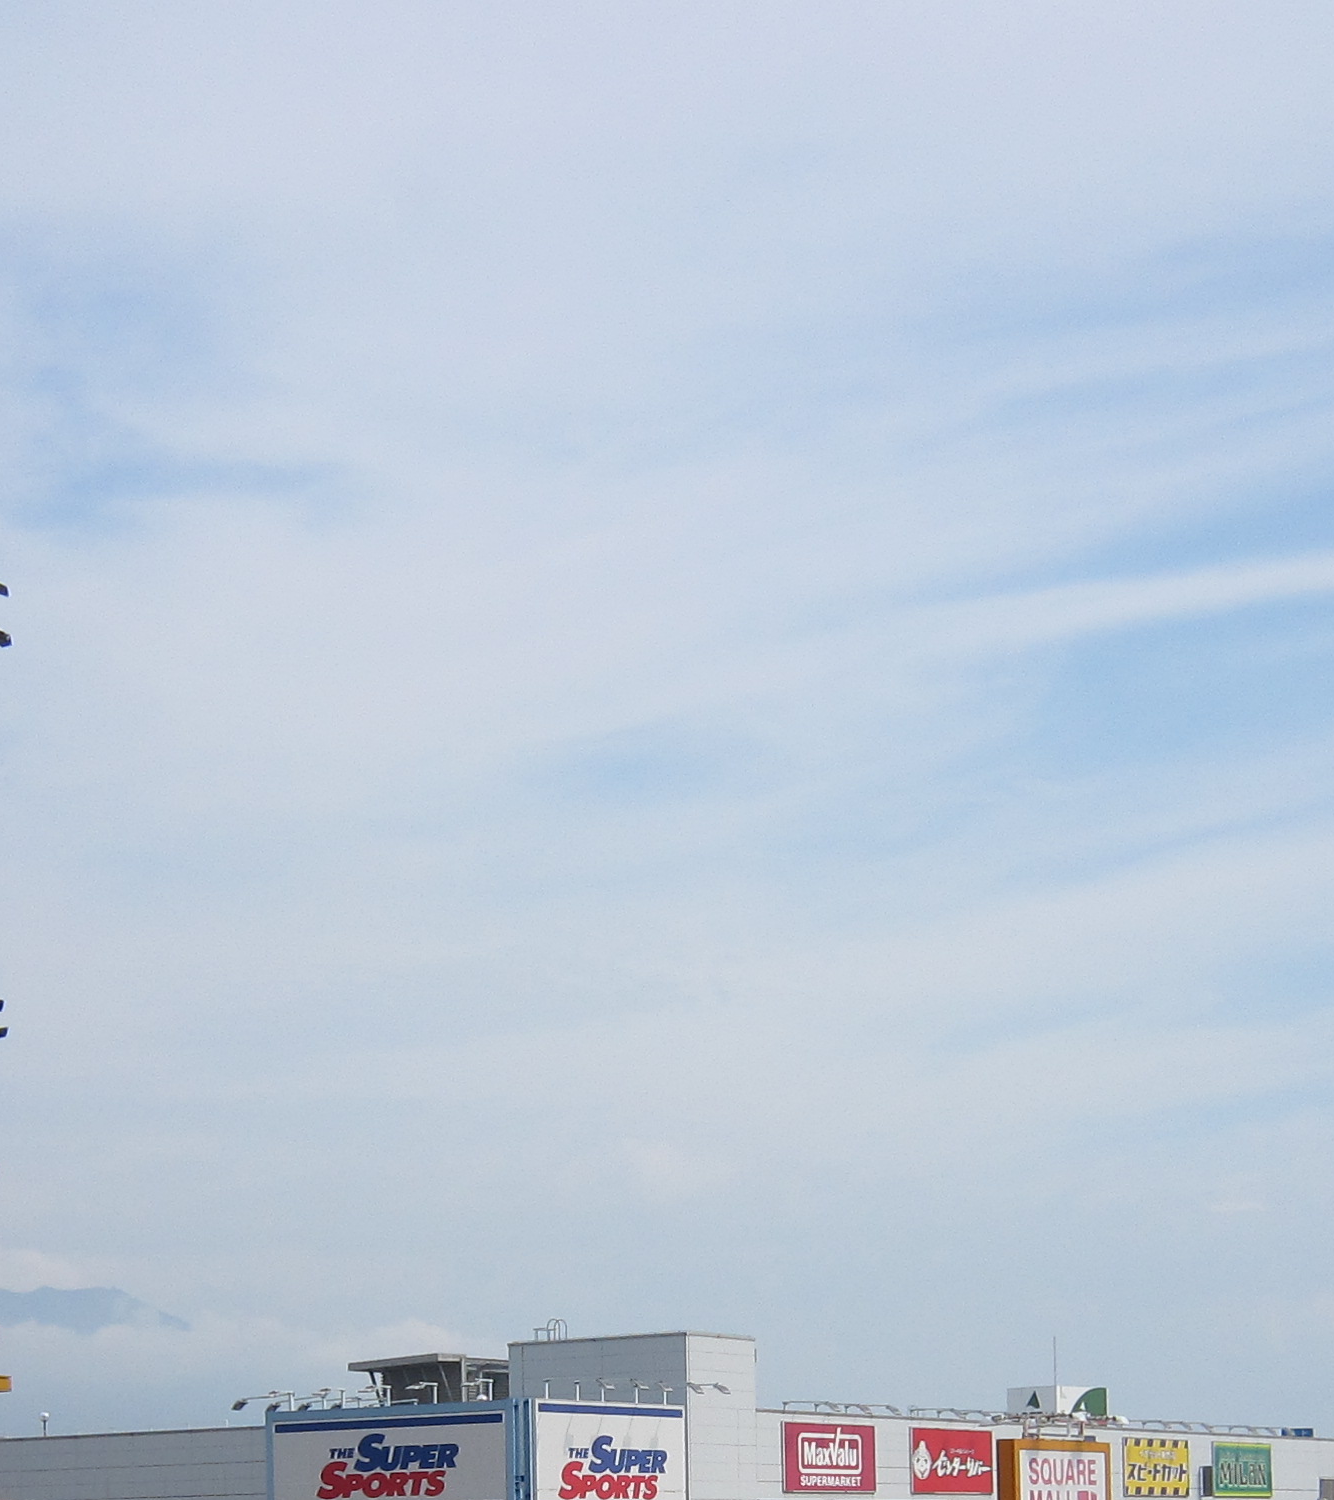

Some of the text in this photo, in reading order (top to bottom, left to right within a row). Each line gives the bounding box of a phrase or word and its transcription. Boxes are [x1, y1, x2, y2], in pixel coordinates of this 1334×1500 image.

[329, 1433, 459, 1471] THE SUPER
[568, 1435, 667, 1474] THE SUPER
[803, 1427, 857, 1467] MaxValu
[317, 1462, 447, 1500] SPORTS
[558, 1461, 659, 1500] SPORTS
[800, 1475, 862, 1487] SUPERMARKET
[1028, 1457, 1097, 1486] SQUARE
[1127, 1462, 1188, 1482] スピードカット
